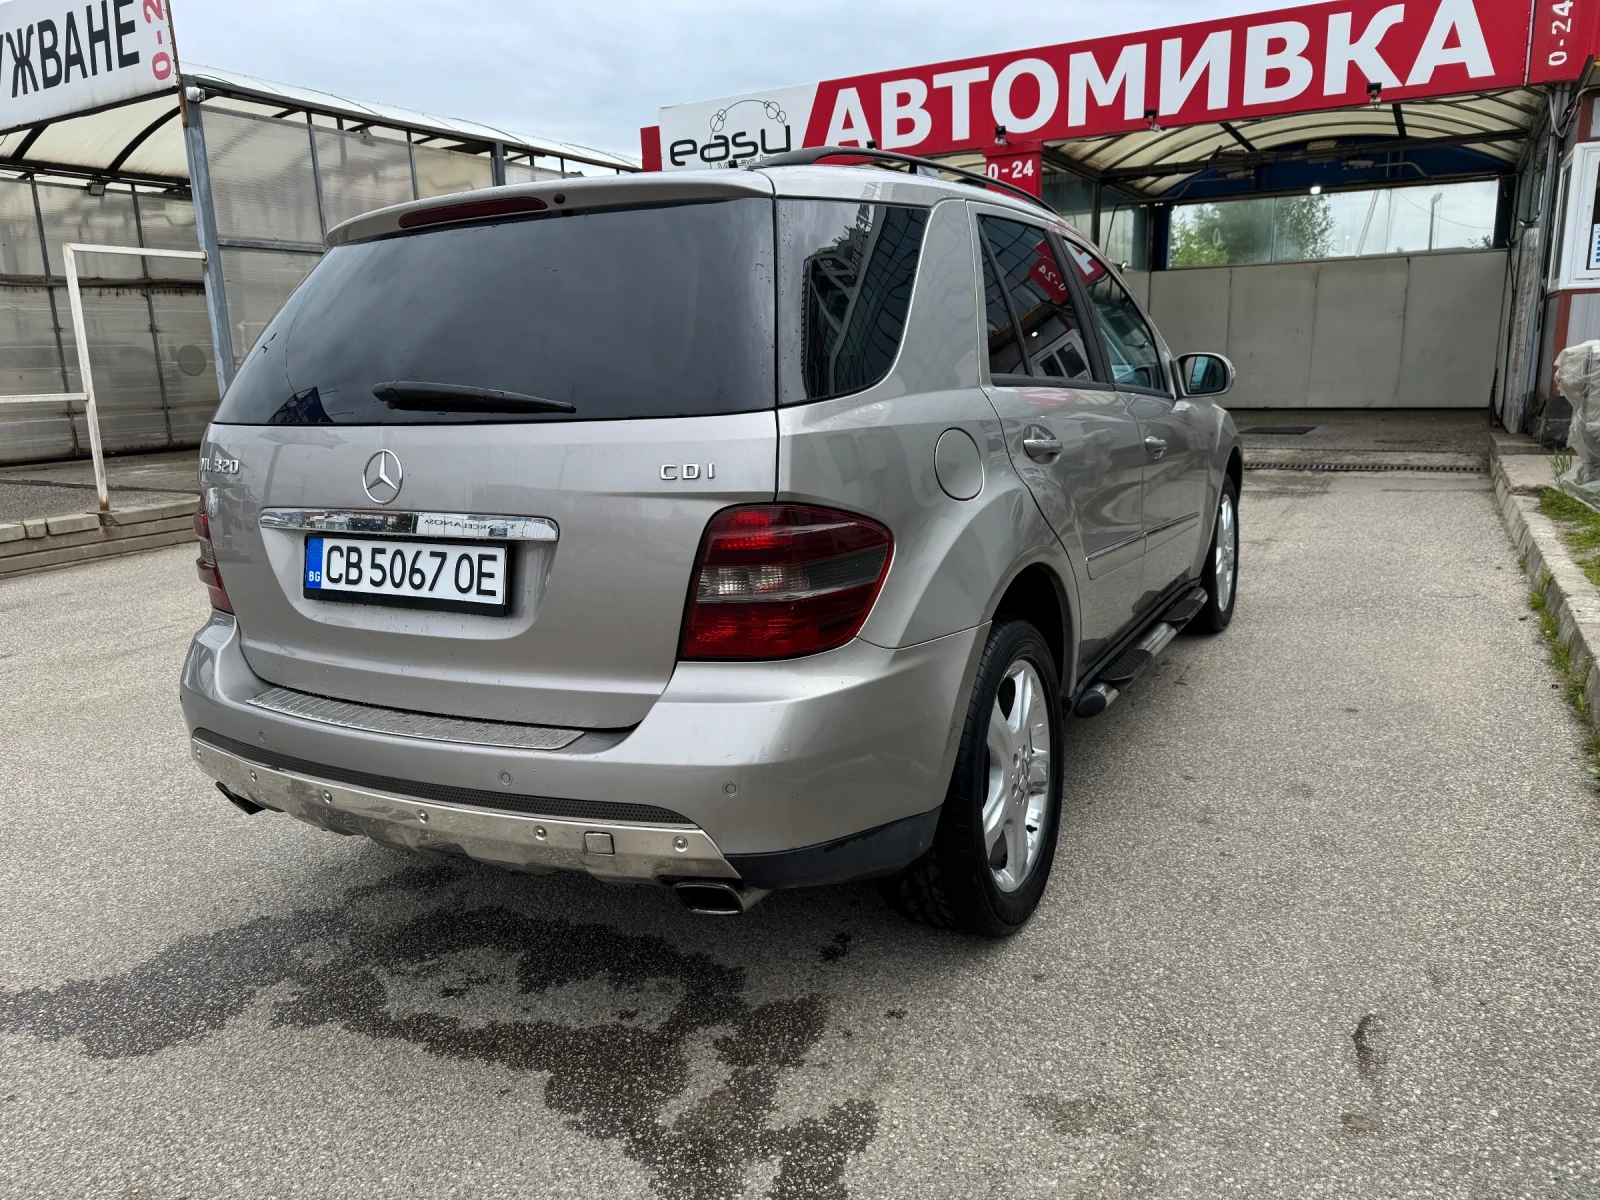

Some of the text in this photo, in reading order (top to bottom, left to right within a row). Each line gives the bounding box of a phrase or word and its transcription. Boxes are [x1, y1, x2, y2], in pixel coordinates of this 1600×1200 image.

[0, 0, 140, 98] ЖВАНЕ
[1548, 0, 1573, 66] 0-24
[824, 0, 1496, 150] АВТОМИВКА
[987, 159, 1034, 180] 0-24
[660, 462, 716, 481] CDI
[308, 571, 321, 582] BG
